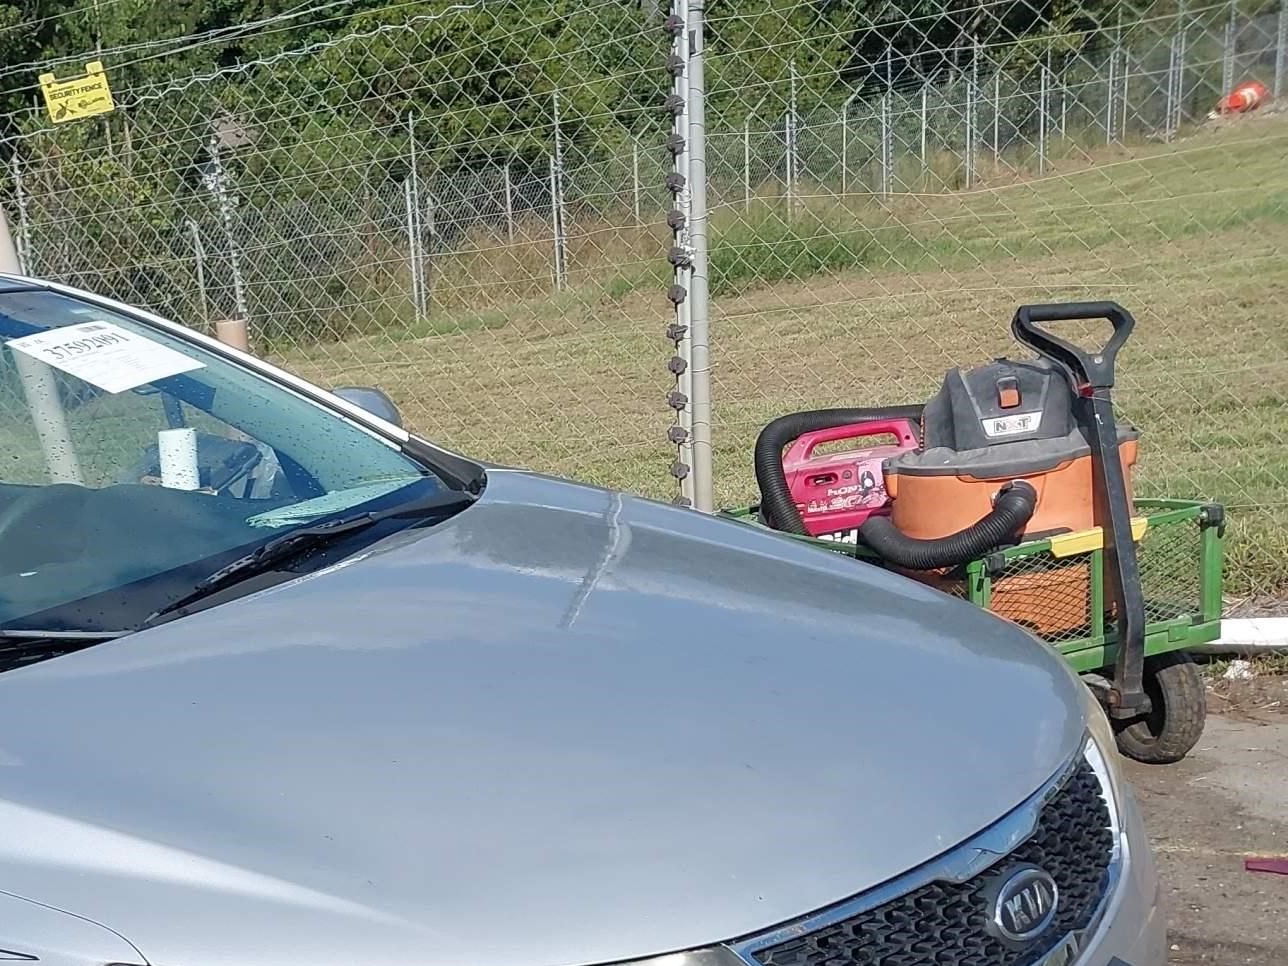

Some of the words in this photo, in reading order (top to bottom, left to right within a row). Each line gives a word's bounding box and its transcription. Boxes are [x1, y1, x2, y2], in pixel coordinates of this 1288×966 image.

[49, 88, 80, 101] SECURITY
[81, 82, 103, 93] FENCE
[1004, 880, 1052, 931] KIA
